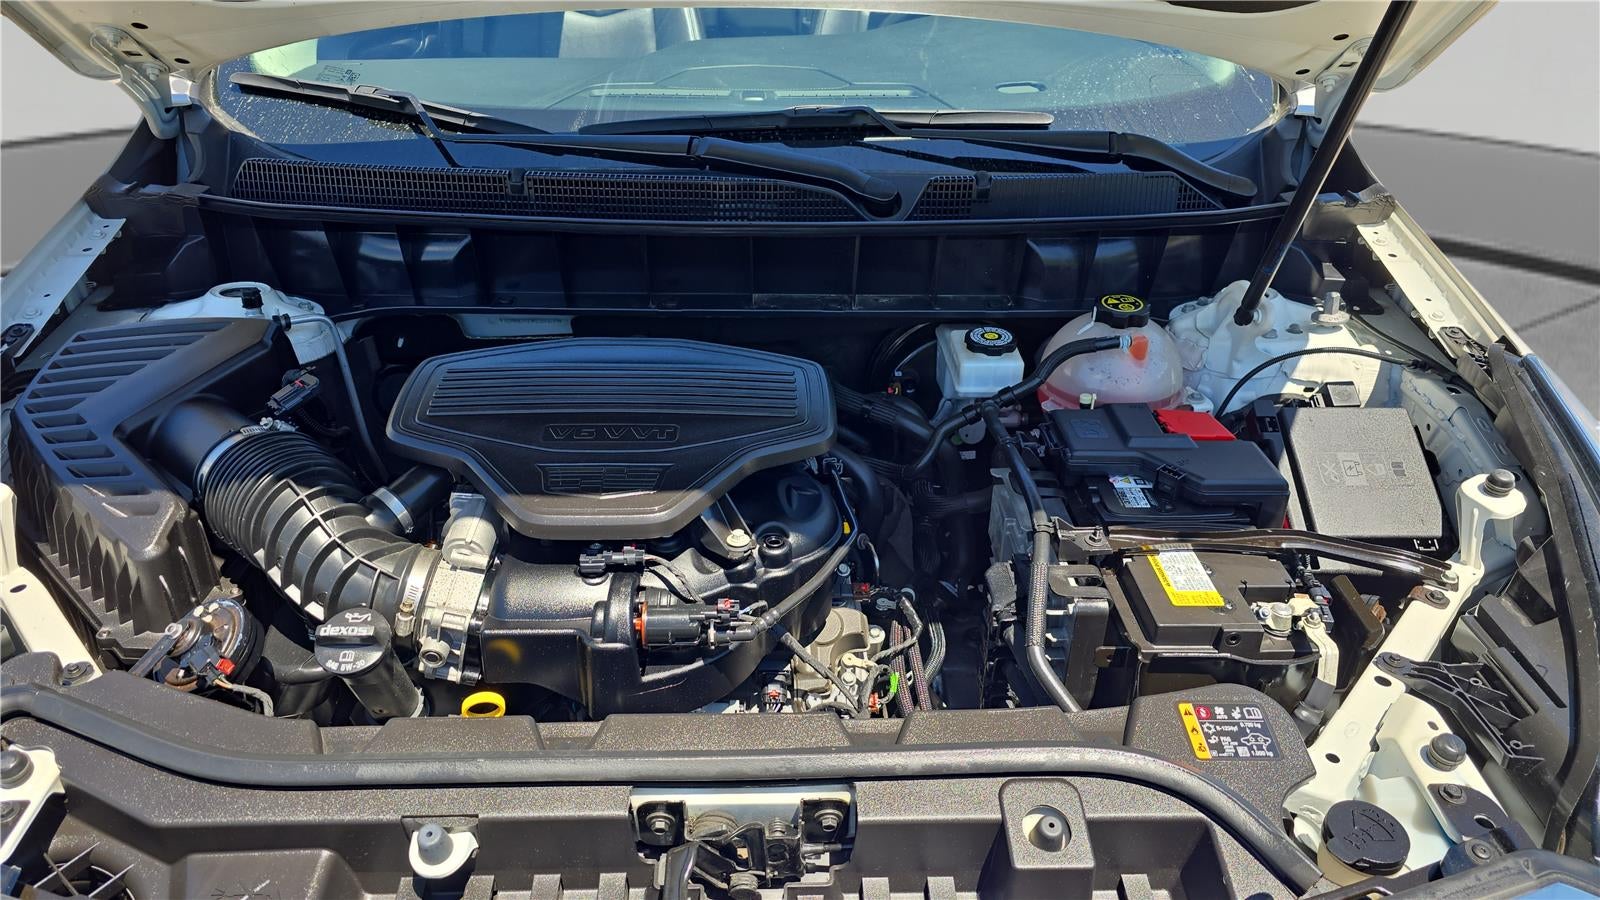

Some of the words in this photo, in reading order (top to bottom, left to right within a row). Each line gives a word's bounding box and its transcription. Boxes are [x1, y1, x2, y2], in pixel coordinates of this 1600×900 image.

[549, 426, 596, 439] V6
[603, 426, 674, 439] VVT
[319, 624, 368, 637] dexos
